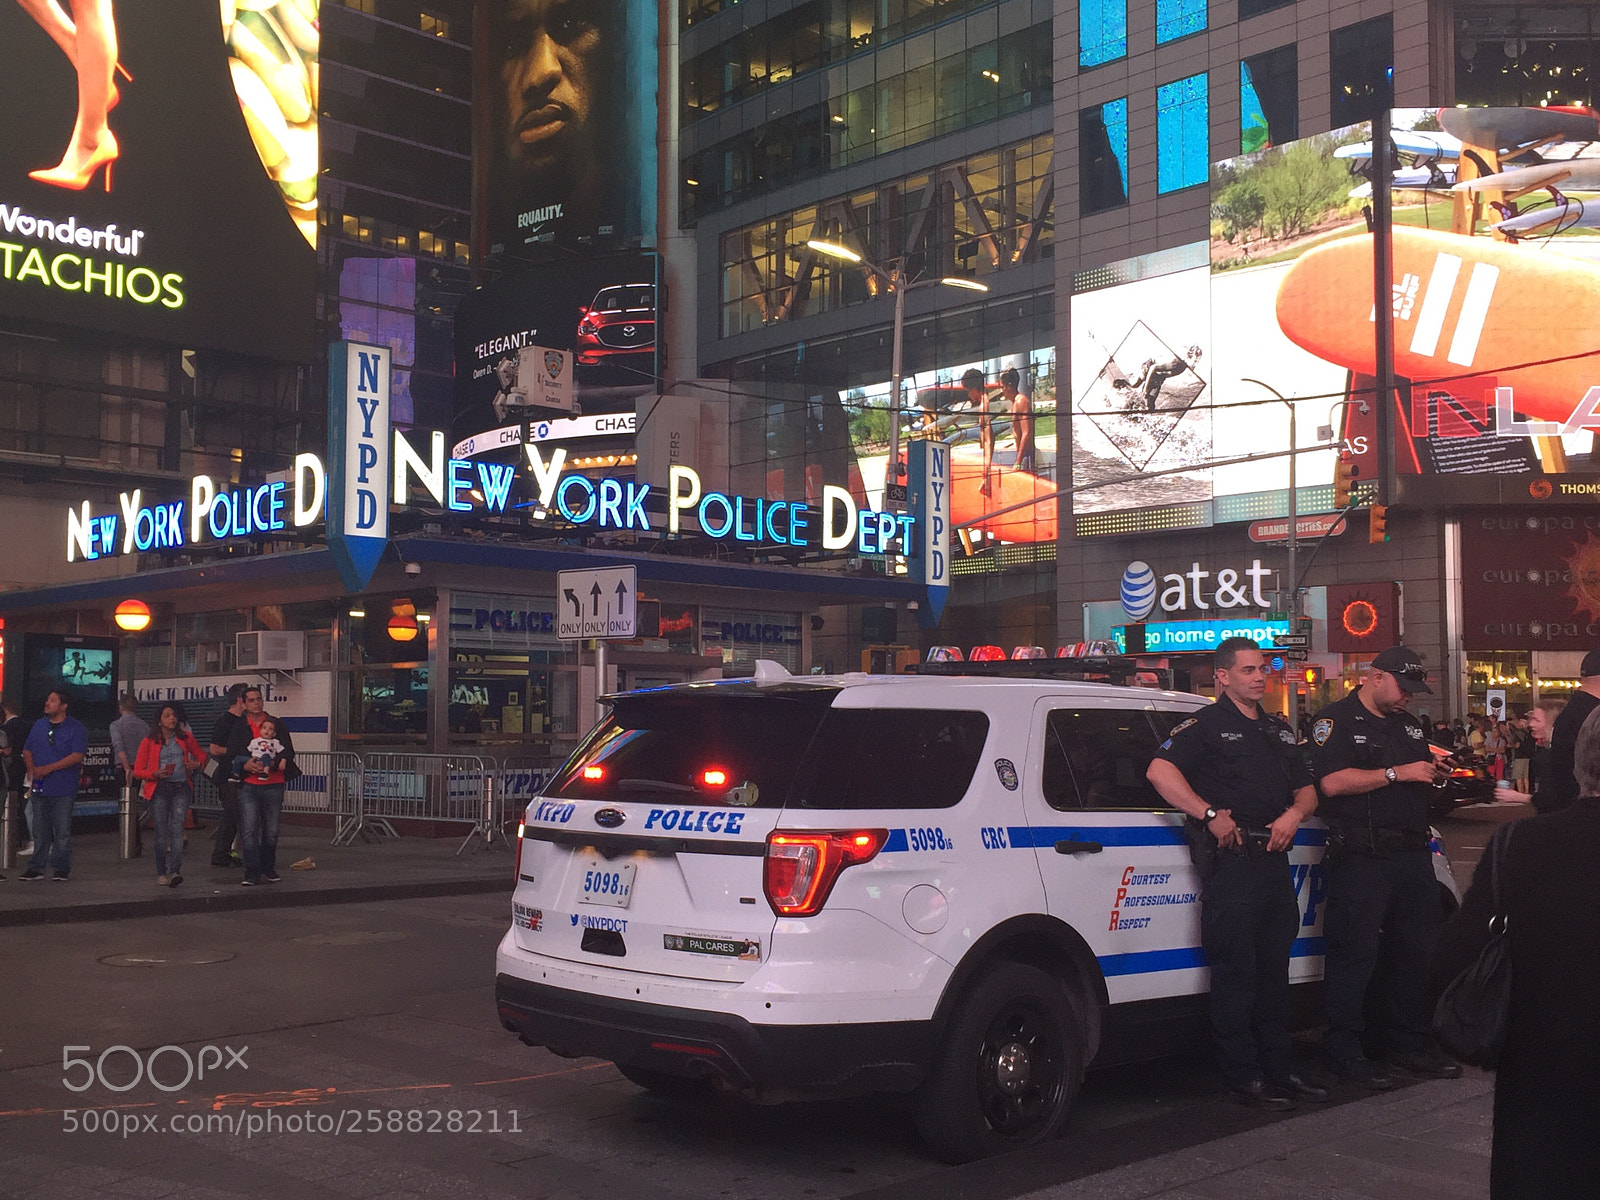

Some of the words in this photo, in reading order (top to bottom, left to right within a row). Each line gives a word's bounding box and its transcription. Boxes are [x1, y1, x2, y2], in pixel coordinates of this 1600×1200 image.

[517, 203, 564, 228] EQUALITY.
[0, 241, 184, 308] TACHIOS
[355, 352, 381, 530] NYPD
[500, 426, 535, 443] CHAE
[524, 442, 652, 532] YORK
[668, 464, 808, 548] POLICE
[822, 484, 916, 558] DEPT
[119, 489, 184, 555] YORK
[191, 475, 286, 544] POLICE
[931, 447, 944, 580] NYPD
[1159, 559, 1272, 612] at&t
[475, 608, 554, 632] POLICE
[560, 623, 581, 634] ONLY
[585, 622, 606, 633] ONLY
[610, 620, 632, 632] ONLY
[721, 621, 782, 643] POLICE
[1165, 628, 1214, 643] home
[535, 801, 576, 823] NYPD
[645, 809, 745, 834] POLICE
[981, 828, 1007, 849] CRC
[1121, 866, 1171, 886] COURTESY
[1114, 888, 1197, 908] PROFESSIONALISM
[581, 915, 628, 933] @NYPDCT
[1108, 911, 1151, 931] RESPECT
[689, 940, 704, 949] PAL
[705, 942, 735, 953] CARES
